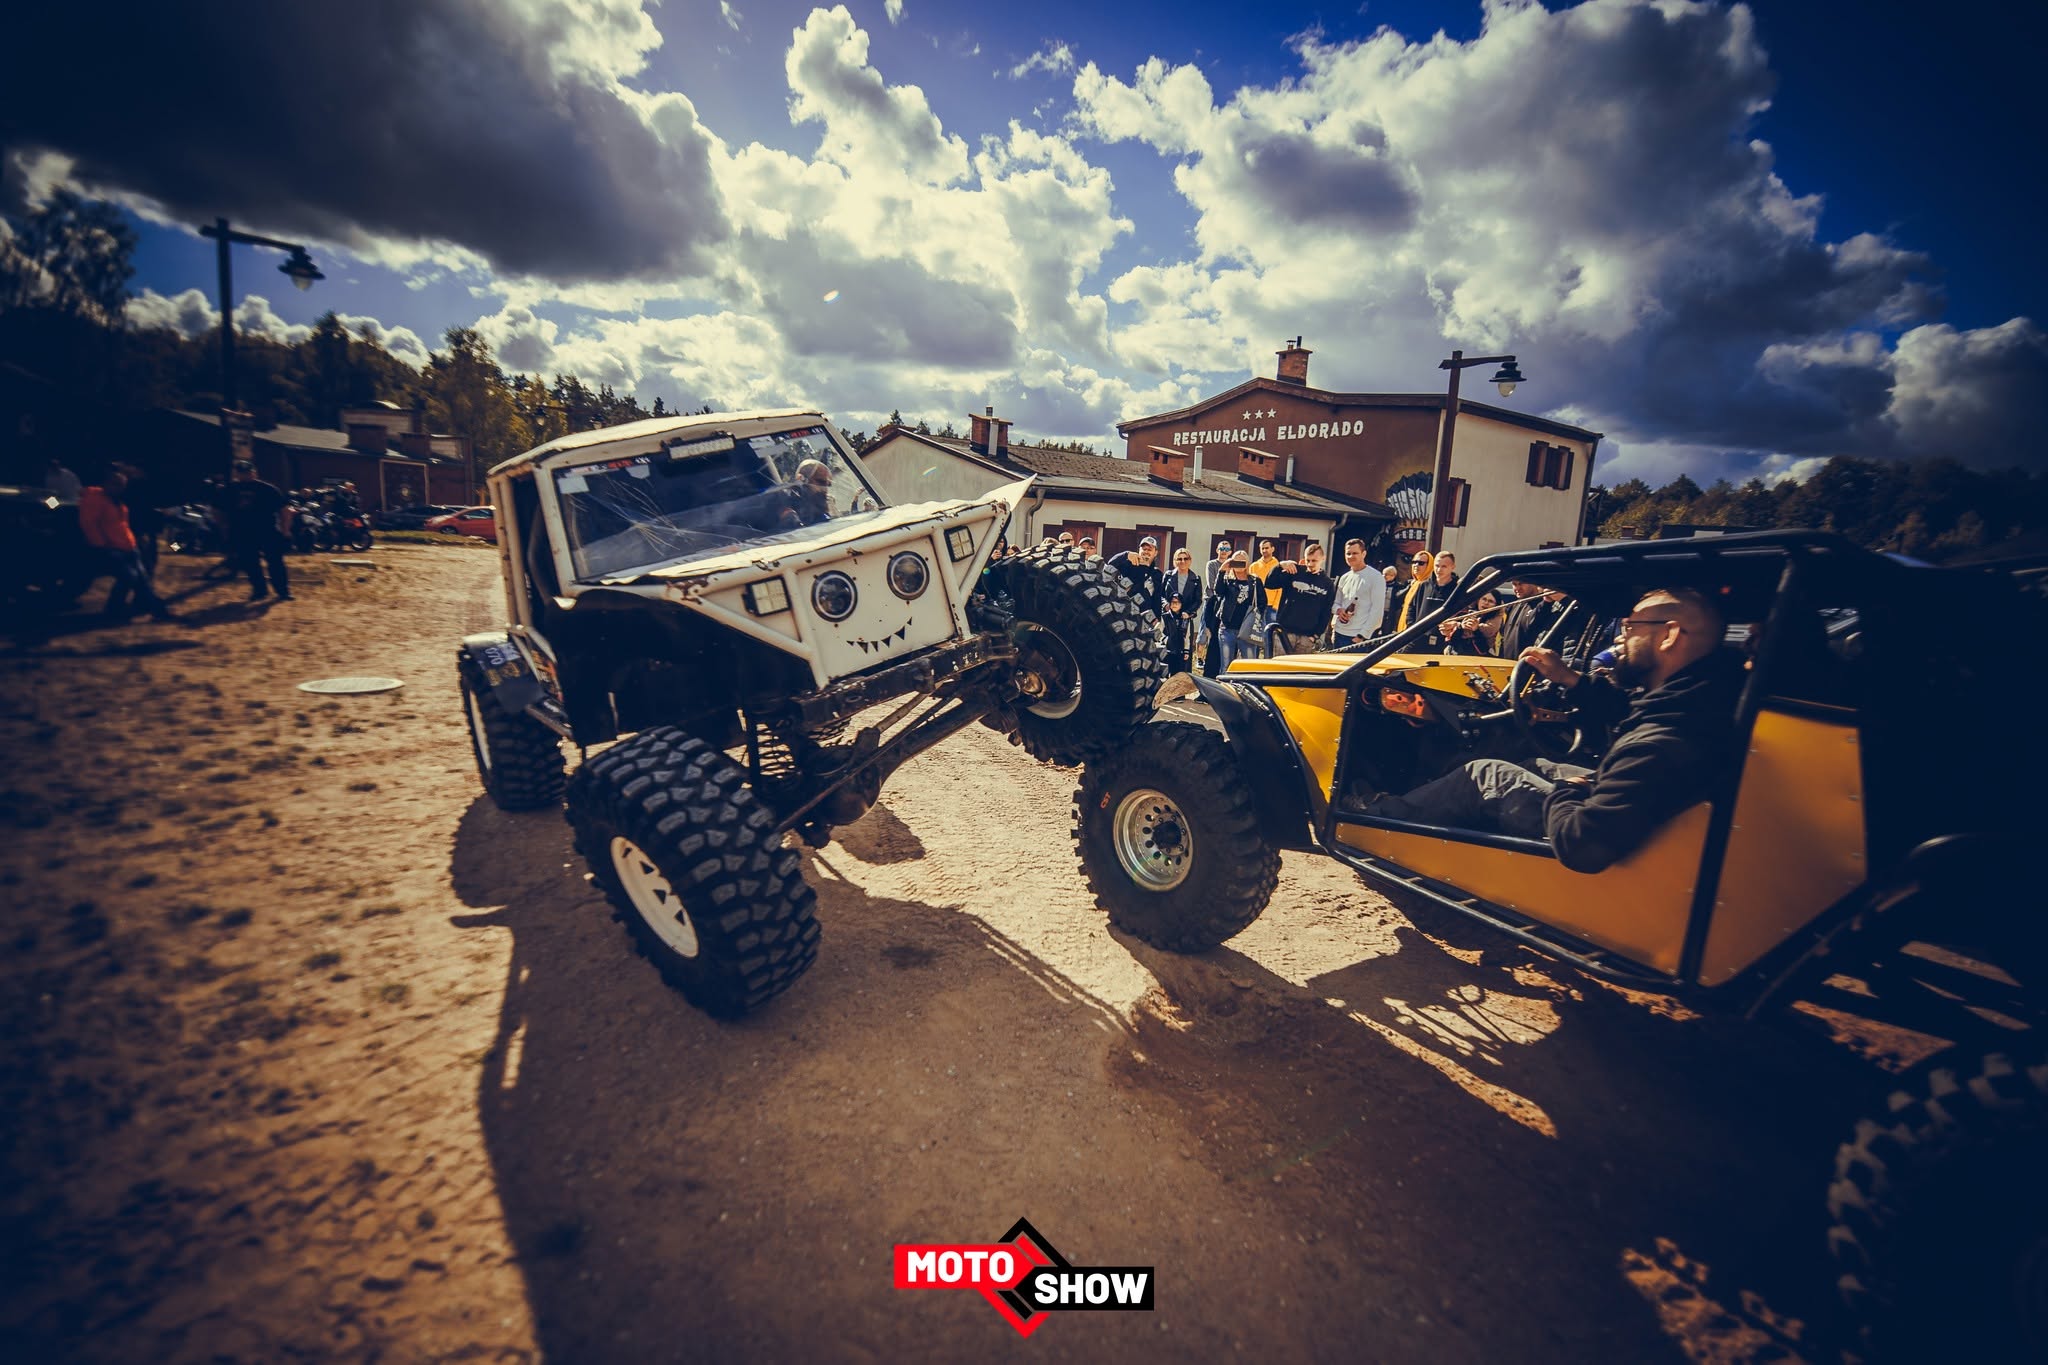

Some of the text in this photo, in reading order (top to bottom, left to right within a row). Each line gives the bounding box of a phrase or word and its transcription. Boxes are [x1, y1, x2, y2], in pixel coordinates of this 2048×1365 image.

[1173, 420, 1365, 446] RESTAURACJA ELDORADO
[485, 647, 504, 665] 070
